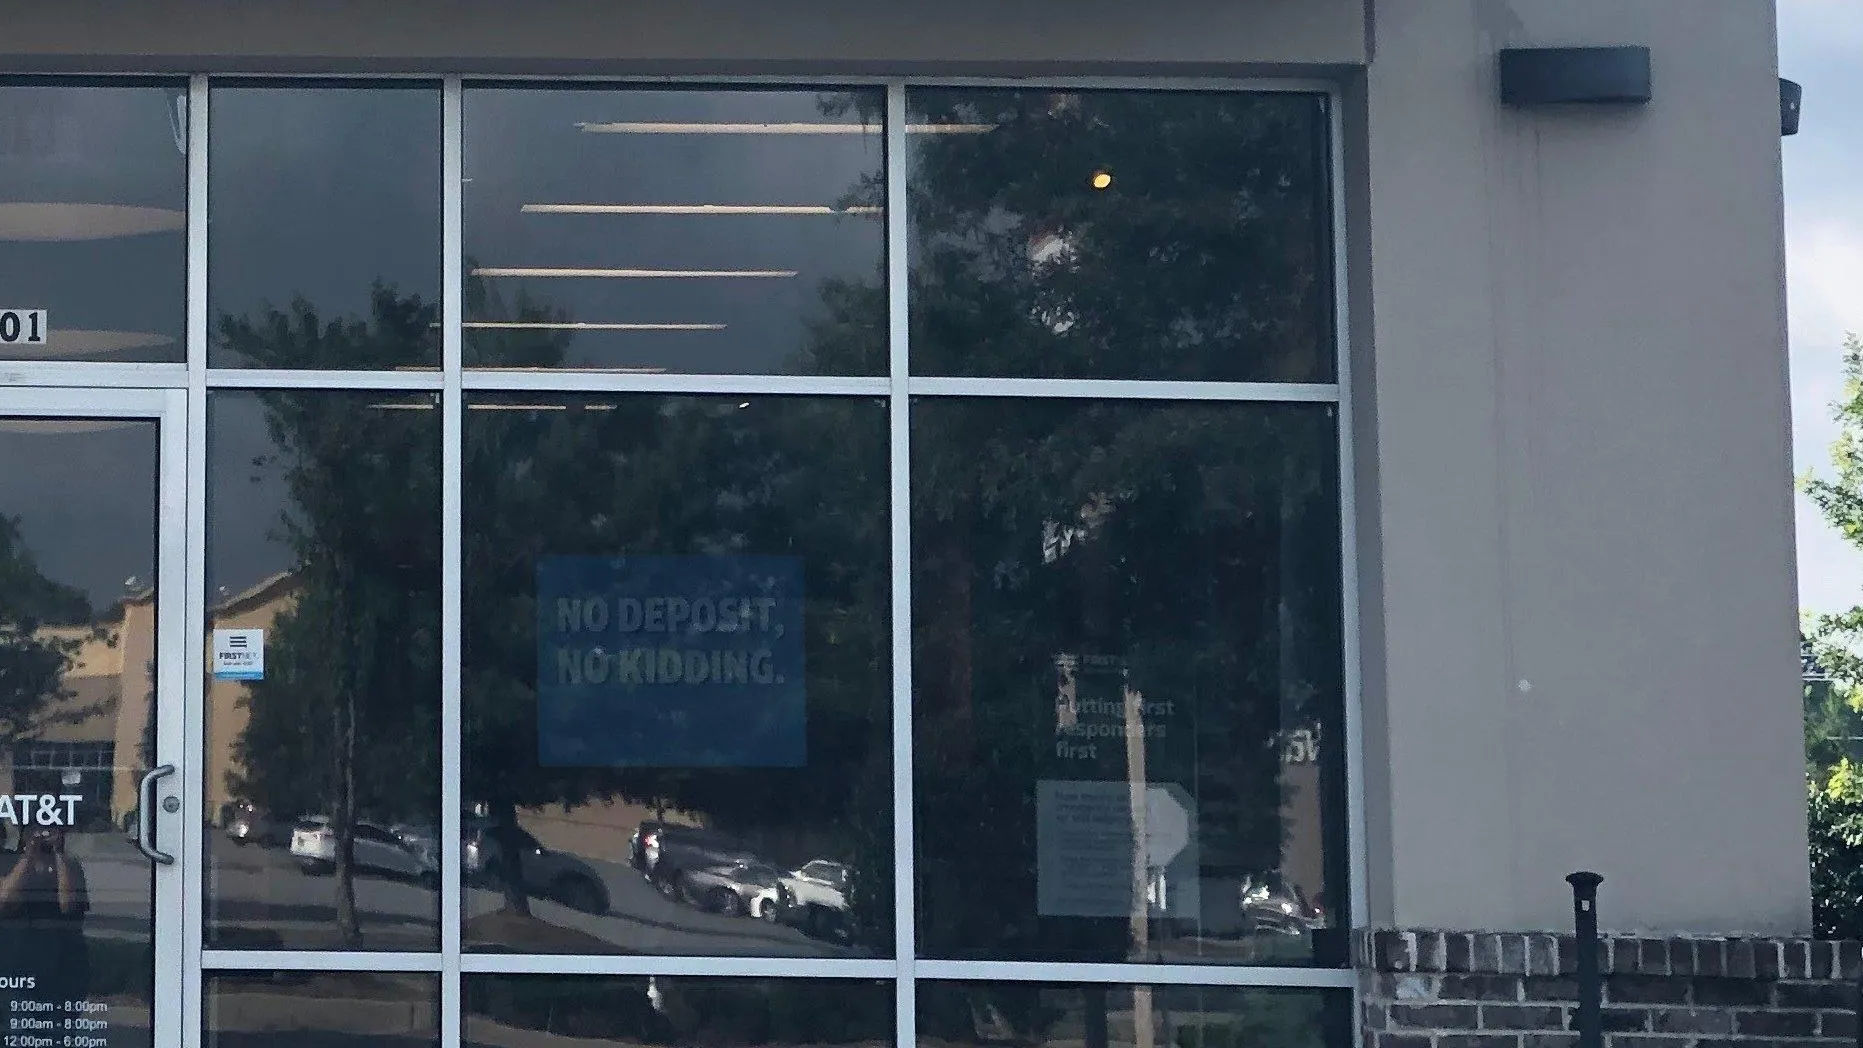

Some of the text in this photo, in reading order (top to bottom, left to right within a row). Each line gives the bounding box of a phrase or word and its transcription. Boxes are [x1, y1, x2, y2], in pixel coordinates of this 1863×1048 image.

[557, 597, 785, 637] NO DEPOSIT,
[557, 649, 786, 684] NO KIDDING.
[1056, 697, 1125, 719] utting
[1056, 722, 1167, 740] responrs
[9, 1000, 54, 1012] 9:00am
[63, 1000, 108, 1015] 8:00pm
[9, 1018, 54, 1030] 9:00am
[63, 1018, 108, 1033] 8:00pm
[3, 1035, 54, 1048] 12:00pm
[63, 1035, 108, 1048] 6:00pm
